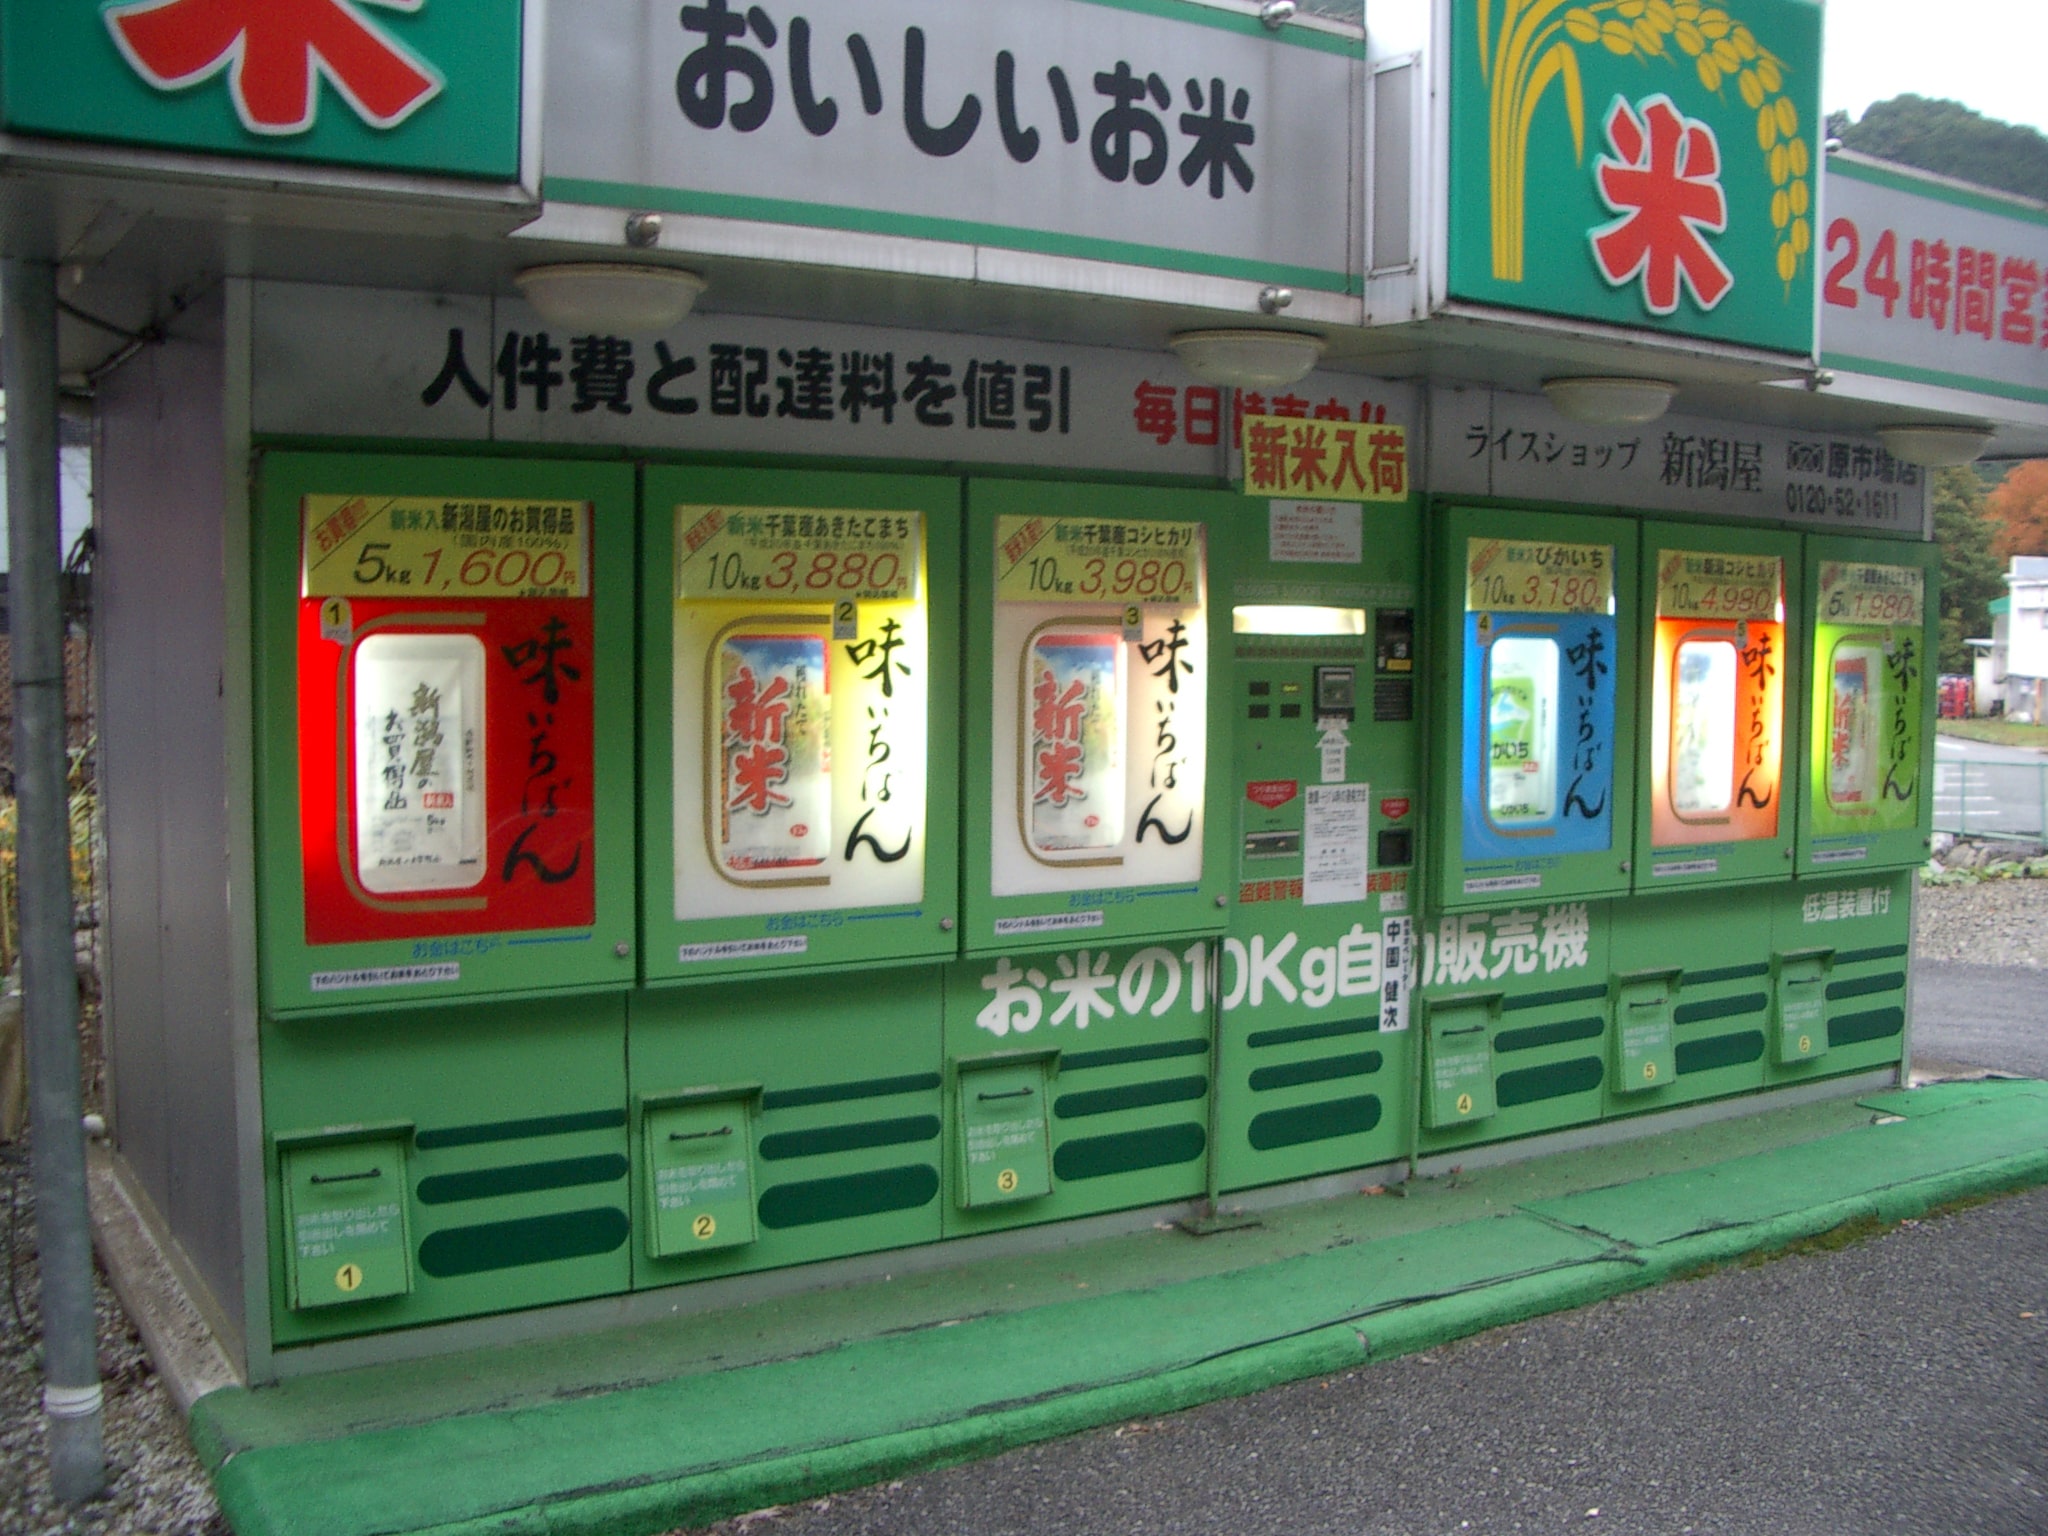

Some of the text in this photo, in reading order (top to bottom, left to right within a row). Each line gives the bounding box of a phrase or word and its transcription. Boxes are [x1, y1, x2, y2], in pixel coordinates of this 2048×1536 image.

[676, 0, 1255, 199] おいしいお米
[1589, 93, 1734, 316] 米
[1824, 217, 2048, 350] 24時間営
[422, 329, 1070, 433] 人件費と配達料を値引
[1248, 421, 1405, 495] 新米入荷
[1465, 425, 1764, 495] ライスショップ 新潟屋
[353, 543, 576, 590] 5kg 1,600円
[707, 551, 908, 593] 10kg 3,880円
[1028, 557, 1074, 594] 10kg
[1080, 558, 1193, 599] 3,980円
[330, 602, 340, 625] 1
[838, 602, 853, 622] 2
[1126, 606, 1140, 625] 3
[500, 615, 580, 884] 味いちばん
[725, 666, 792, 813] 新米
[844, 618, 912, 863] 味いちばん
[1033, 670, 1085, 805] 新米
[1136, 619, 1194, 845] 味いちばん
[1563, 627, 1608, 819] 味いちばん
[1737, 632, 1775, 809] 味いちばん
[1882, 637, 1918, 801] 味いちばん
[1801, 887, 1891, 924] 低温装置付
[976, 904, 1590, 1036] お米の10Kg自販売機
[1645, 1063, 1654, 1080] 5
[1800, 1036, 1809, 1051] 6
[1459, 1096, 1469, 1113] 4
[1001, 1171, 1014, 1190] 3
[697, 1216, 711, 1237] 2
[343, 1266, 353, 1287] 1
